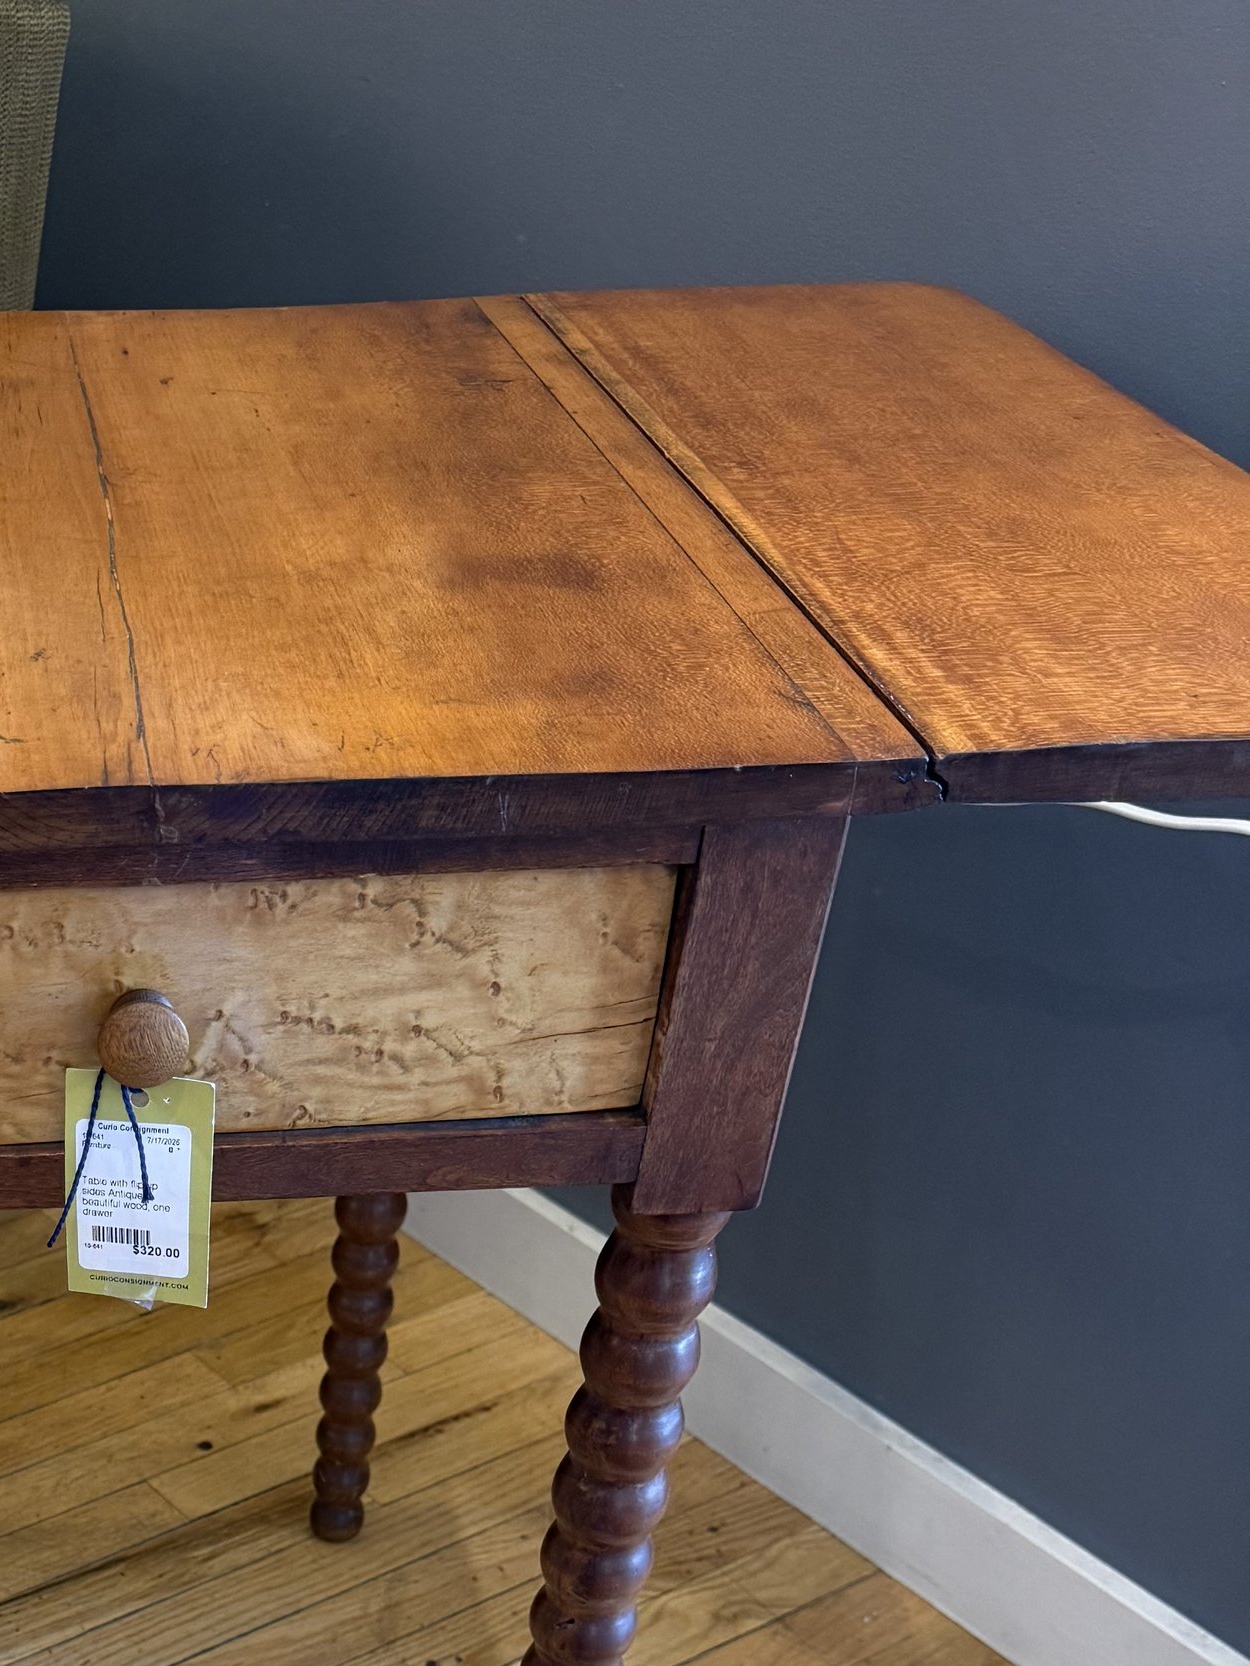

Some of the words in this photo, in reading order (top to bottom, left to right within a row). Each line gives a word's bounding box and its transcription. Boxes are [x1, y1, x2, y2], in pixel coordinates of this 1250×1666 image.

[98, 1122, 118, 1131] Curio
[120, 1124, 169, 1135] Conignment
[82, 1175, 108, 1186] Table
[110, 1179, 128, 1187] with
[82, 1188, 106, 1196] sides
[82, 1197, 121, 1208] beautiful
[123, 1200, 150, 1212] wood,
[153, 1204, 171, 1213] one
[82, 1208, 114, 1218] drawer
[132, 1244, 180, 1258] $320.00
